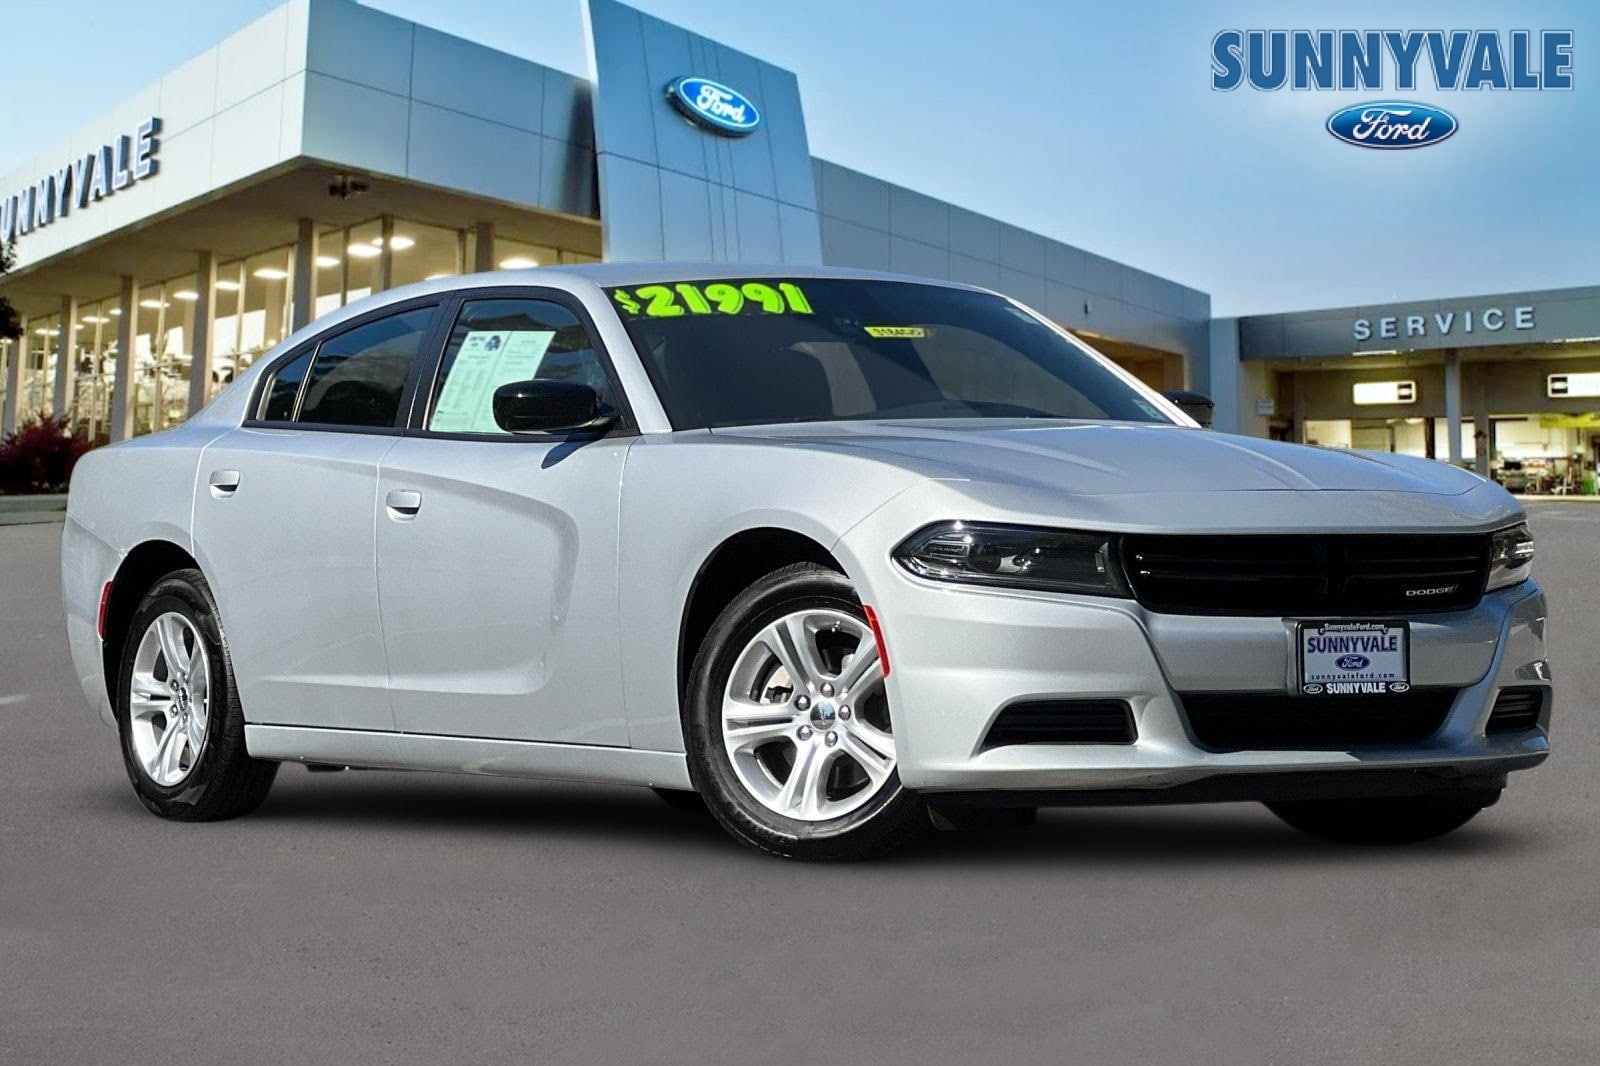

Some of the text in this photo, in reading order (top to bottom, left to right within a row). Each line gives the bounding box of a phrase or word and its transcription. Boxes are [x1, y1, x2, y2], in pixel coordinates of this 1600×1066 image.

[696, 85, 746, 123] Ford
[0, 117, 162, 245] UNNYVALE
[614, 283, 814, 317] $21991
[1353, 306, 1536, 341] SERVICE
[1405, 586, 1454, 597] DODGE
[1324, 622, 1385, 632] SunnyvaleFord.com
[1307, 635, 1398, 653] SUNNYVALE
[1341, 656, 1364, 668] Ford
[1326, 682, 1387, 694] SUNNYVALE
